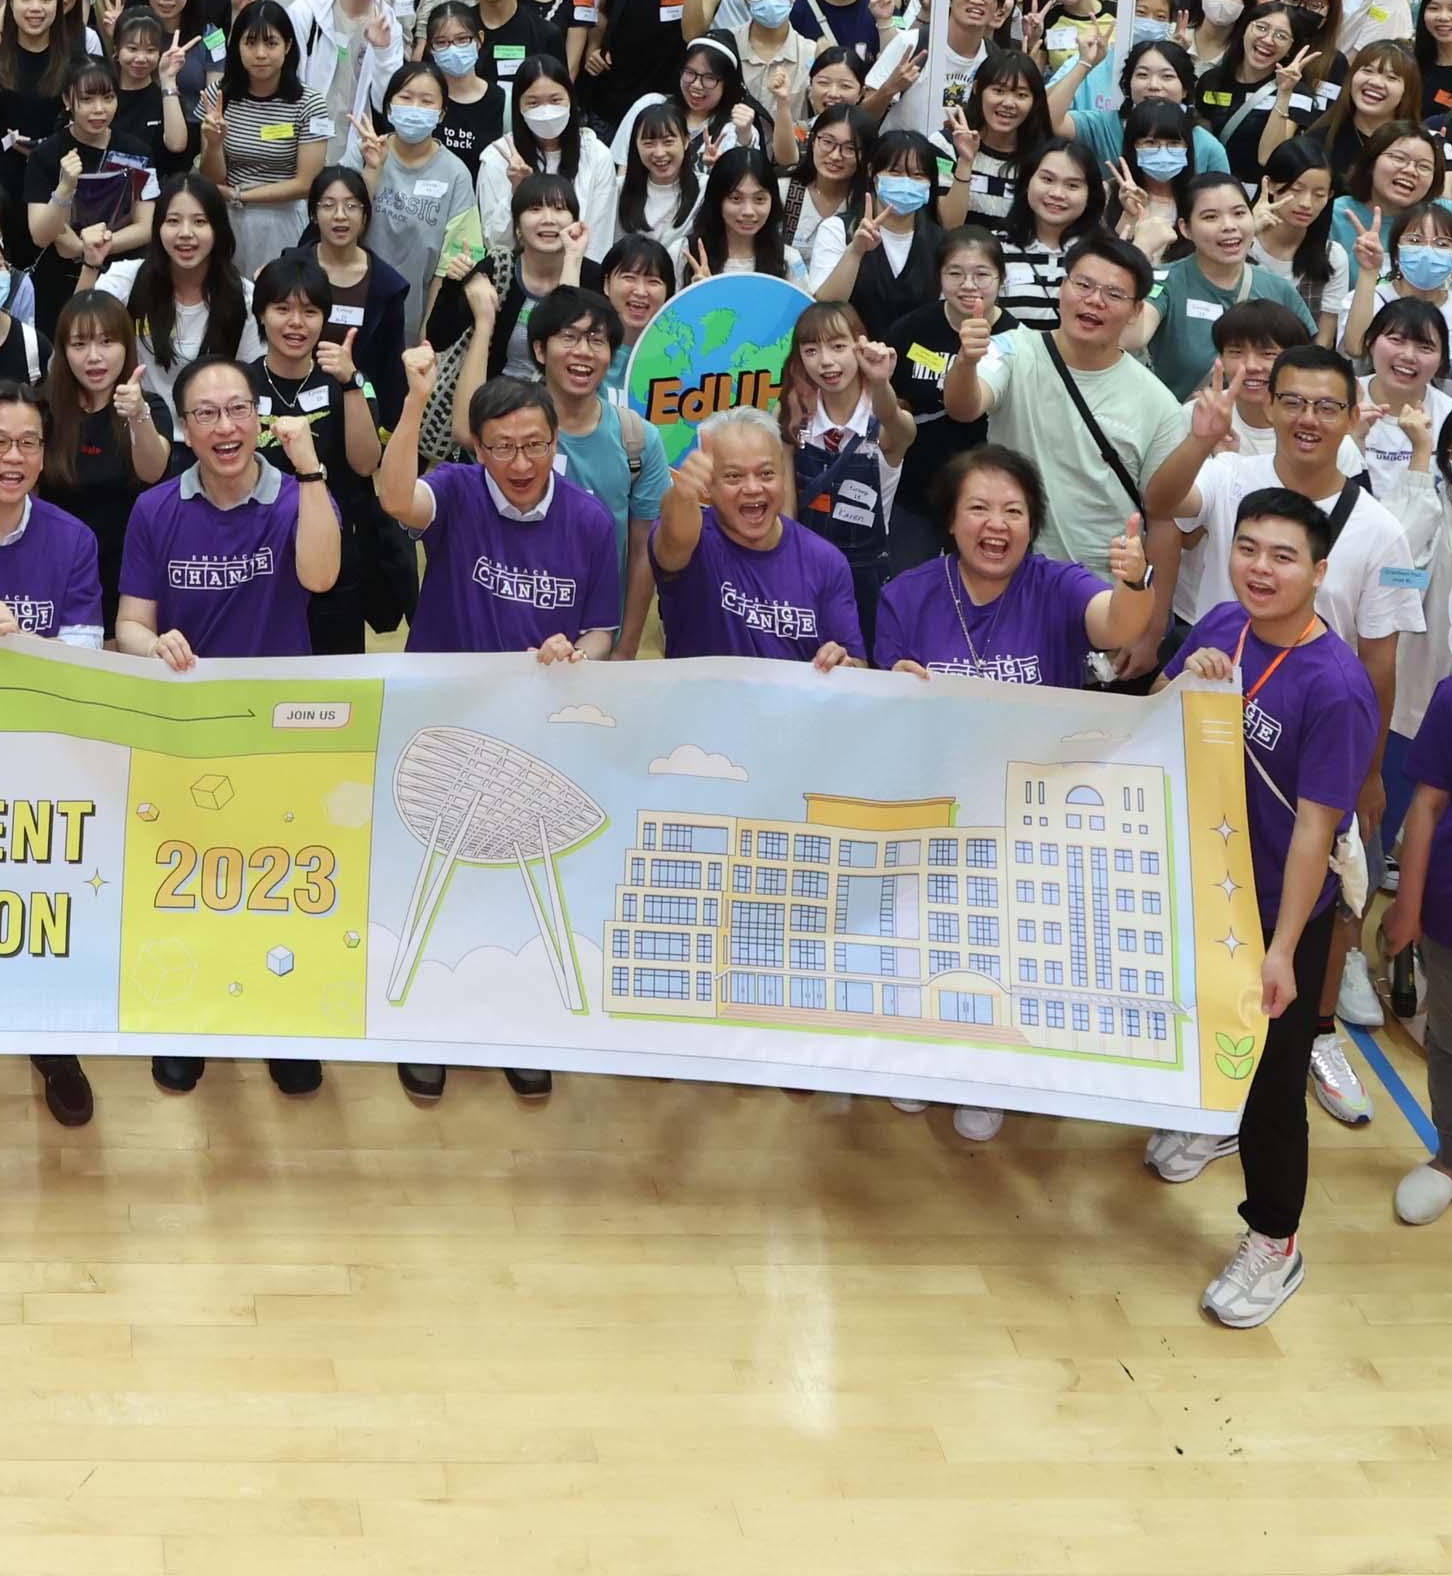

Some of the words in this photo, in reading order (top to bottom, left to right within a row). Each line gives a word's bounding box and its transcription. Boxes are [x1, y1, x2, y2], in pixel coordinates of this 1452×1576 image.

[444, 127, 457, 138] to
[446, 137, 473, 150] back
[647, 369, 783, 425] EdUH
[287, 710, 315, 721] JOIN
[319, 710, 336, 721] US
[154, 840, 339, 916] 2023
